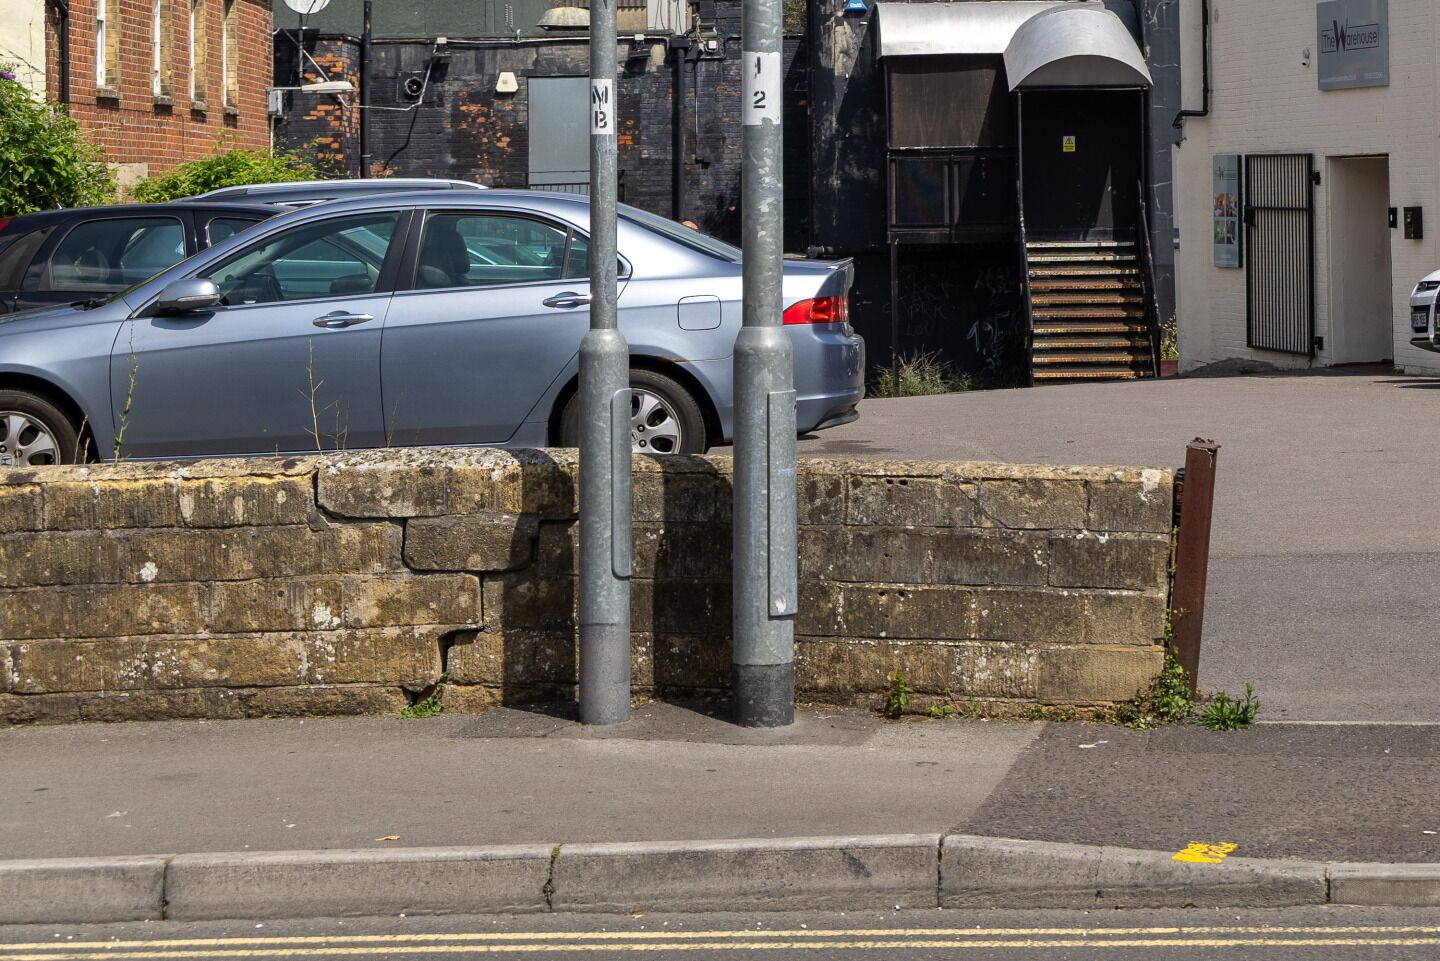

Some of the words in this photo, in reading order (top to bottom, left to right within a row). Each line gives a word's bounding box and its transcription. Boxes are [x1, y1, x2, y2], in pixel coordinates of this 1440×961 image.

[1322, 34, 1336, 49] The
[1333, 17, 1378, 54] Warehouse
[753, 90, 766, 109] 2
[594, 110, 608, 129] B
